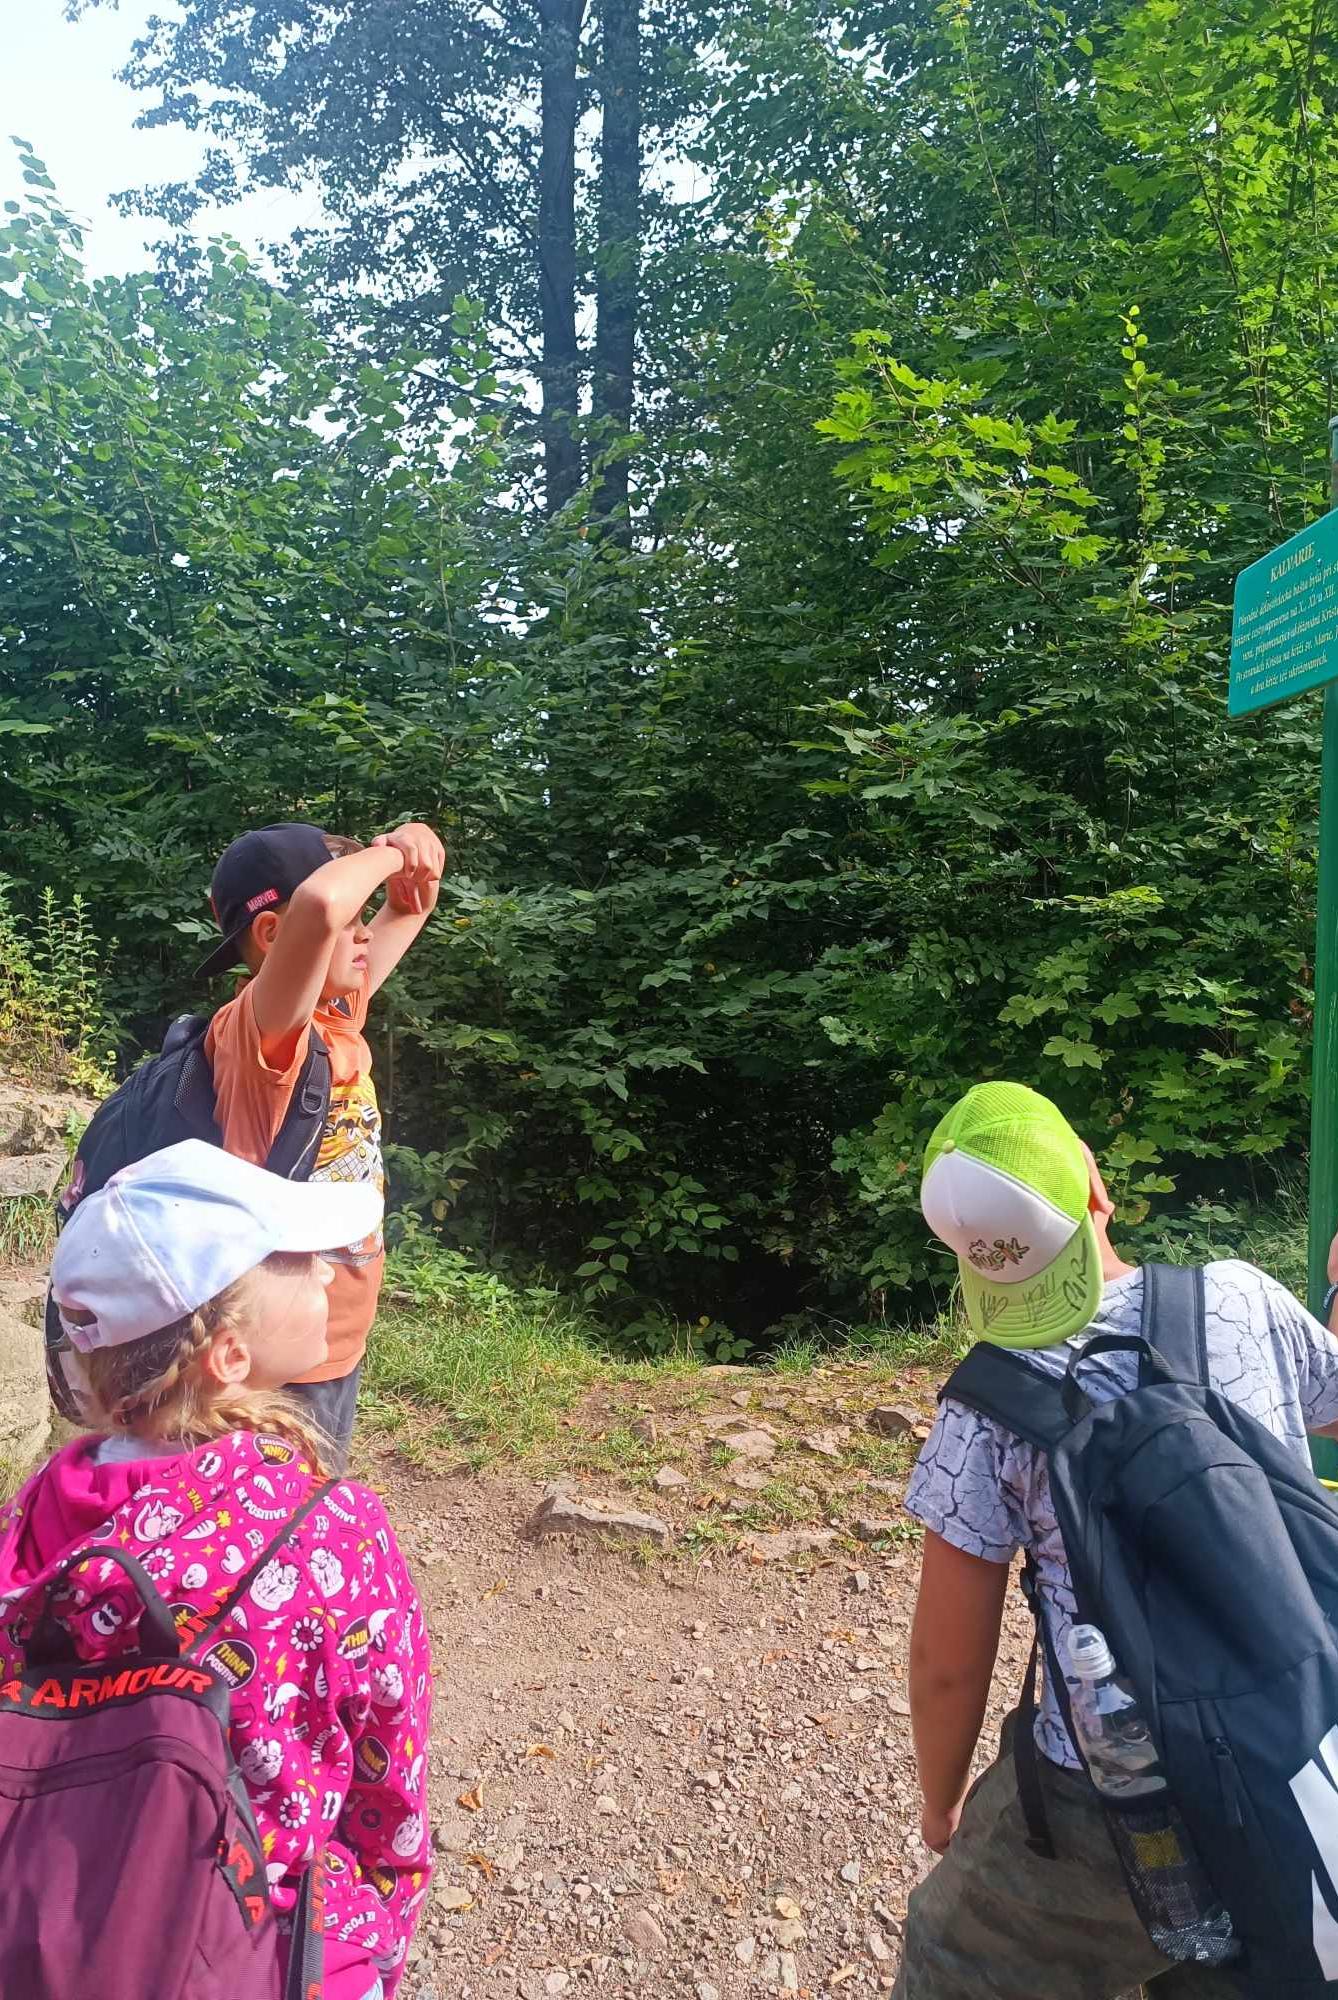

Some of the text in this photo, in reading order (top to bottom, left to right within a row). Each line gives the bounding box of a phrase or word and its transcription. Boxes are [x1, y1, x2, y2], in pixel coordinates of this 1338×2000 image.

[247, 888, 279, 912] MARVEL
[236, 1486, 288, 1521] BE POSITIVE
[344, 1629, 369, 1648] THIN
[205, 1654, 239, 1687] POSITIVE
[217, 1643, 251, 1678] THINK
[31, 1664, 214, 1709] ARMOUR
[310, 1724, 340, 1765] POSITIVE
